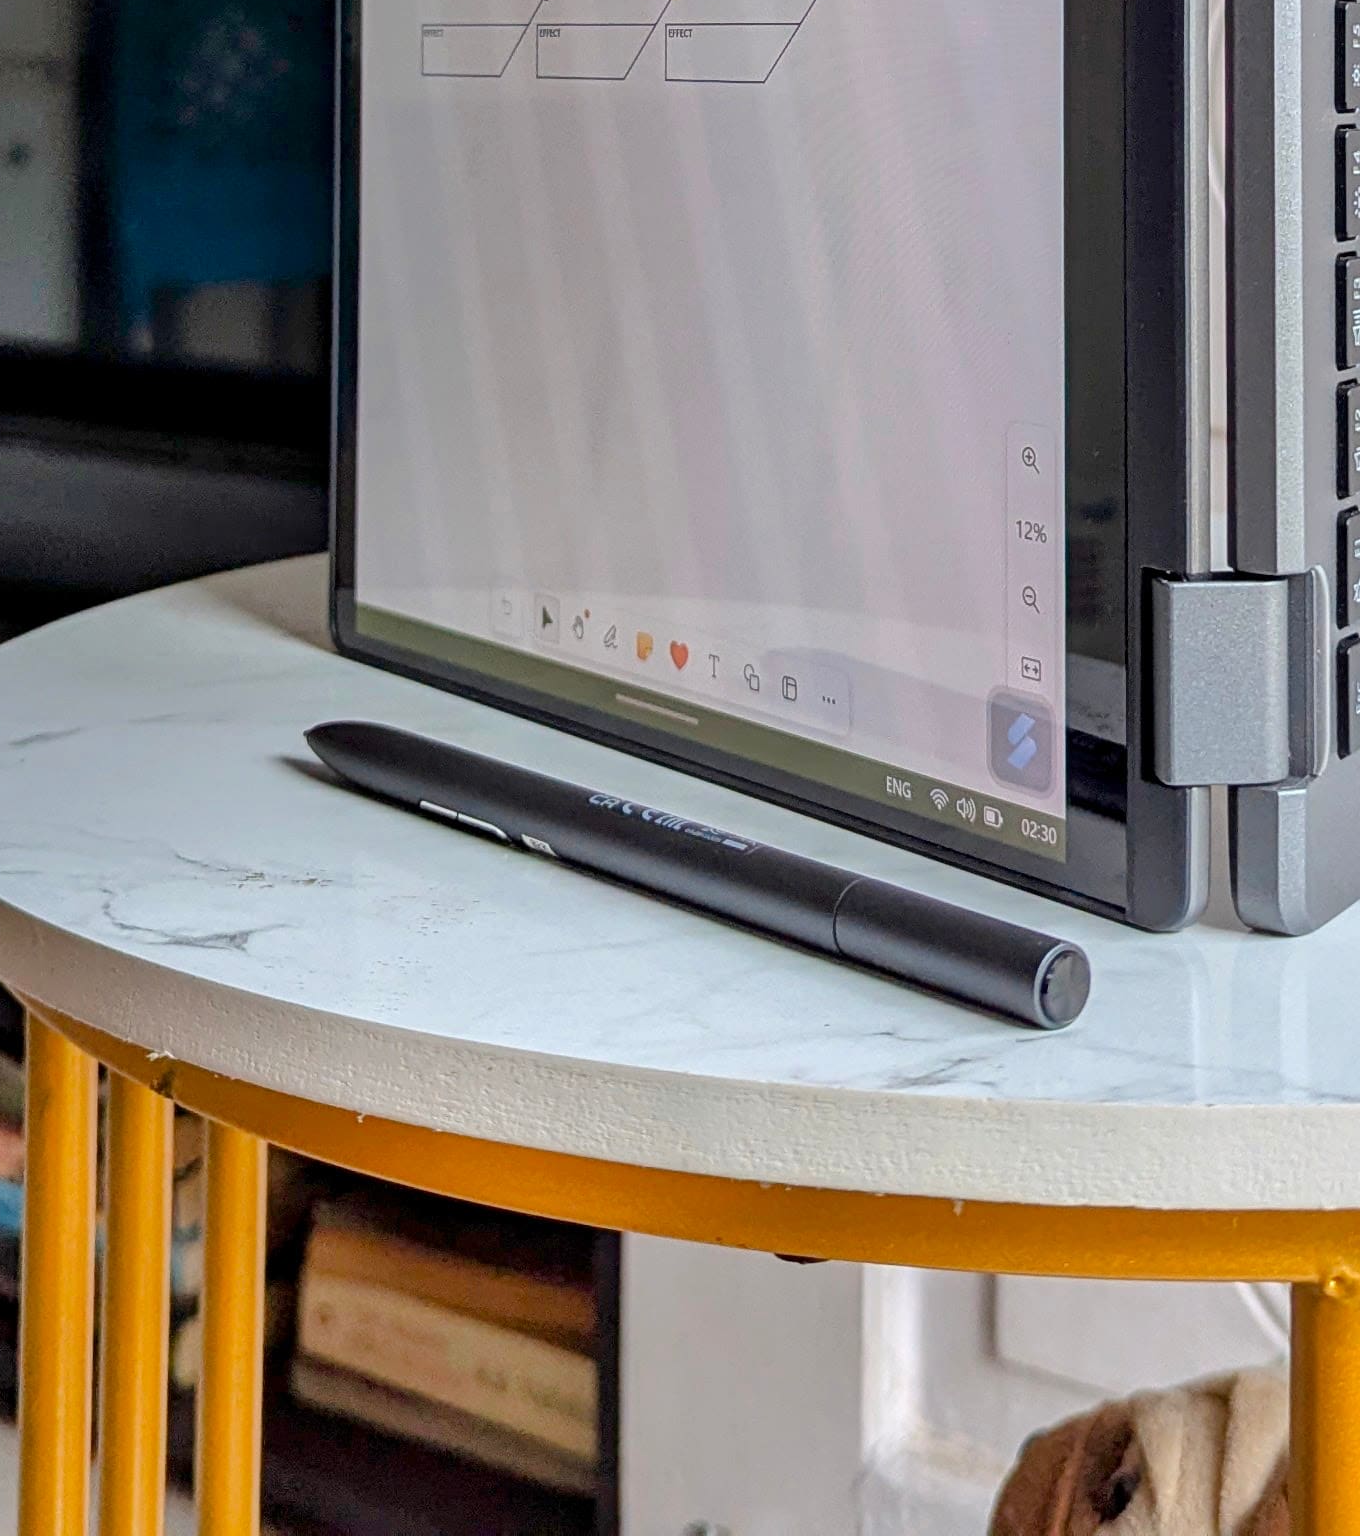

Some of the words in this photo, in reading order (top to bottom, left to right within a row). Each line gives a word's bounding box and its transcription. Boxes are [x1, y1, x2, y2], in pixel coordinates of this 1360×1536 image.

[540, 28, 561, 38] EFFECT
[668, 29, 693, 38] EFFECT
[1353, 24, 1360, 48] F5
[1353, 150, 1360, 174] F4
[1015, 520, 1047, 544] 12%
[886, 775, 912, 799] ENG
[1021, 818, 1057, 845] 02:30
